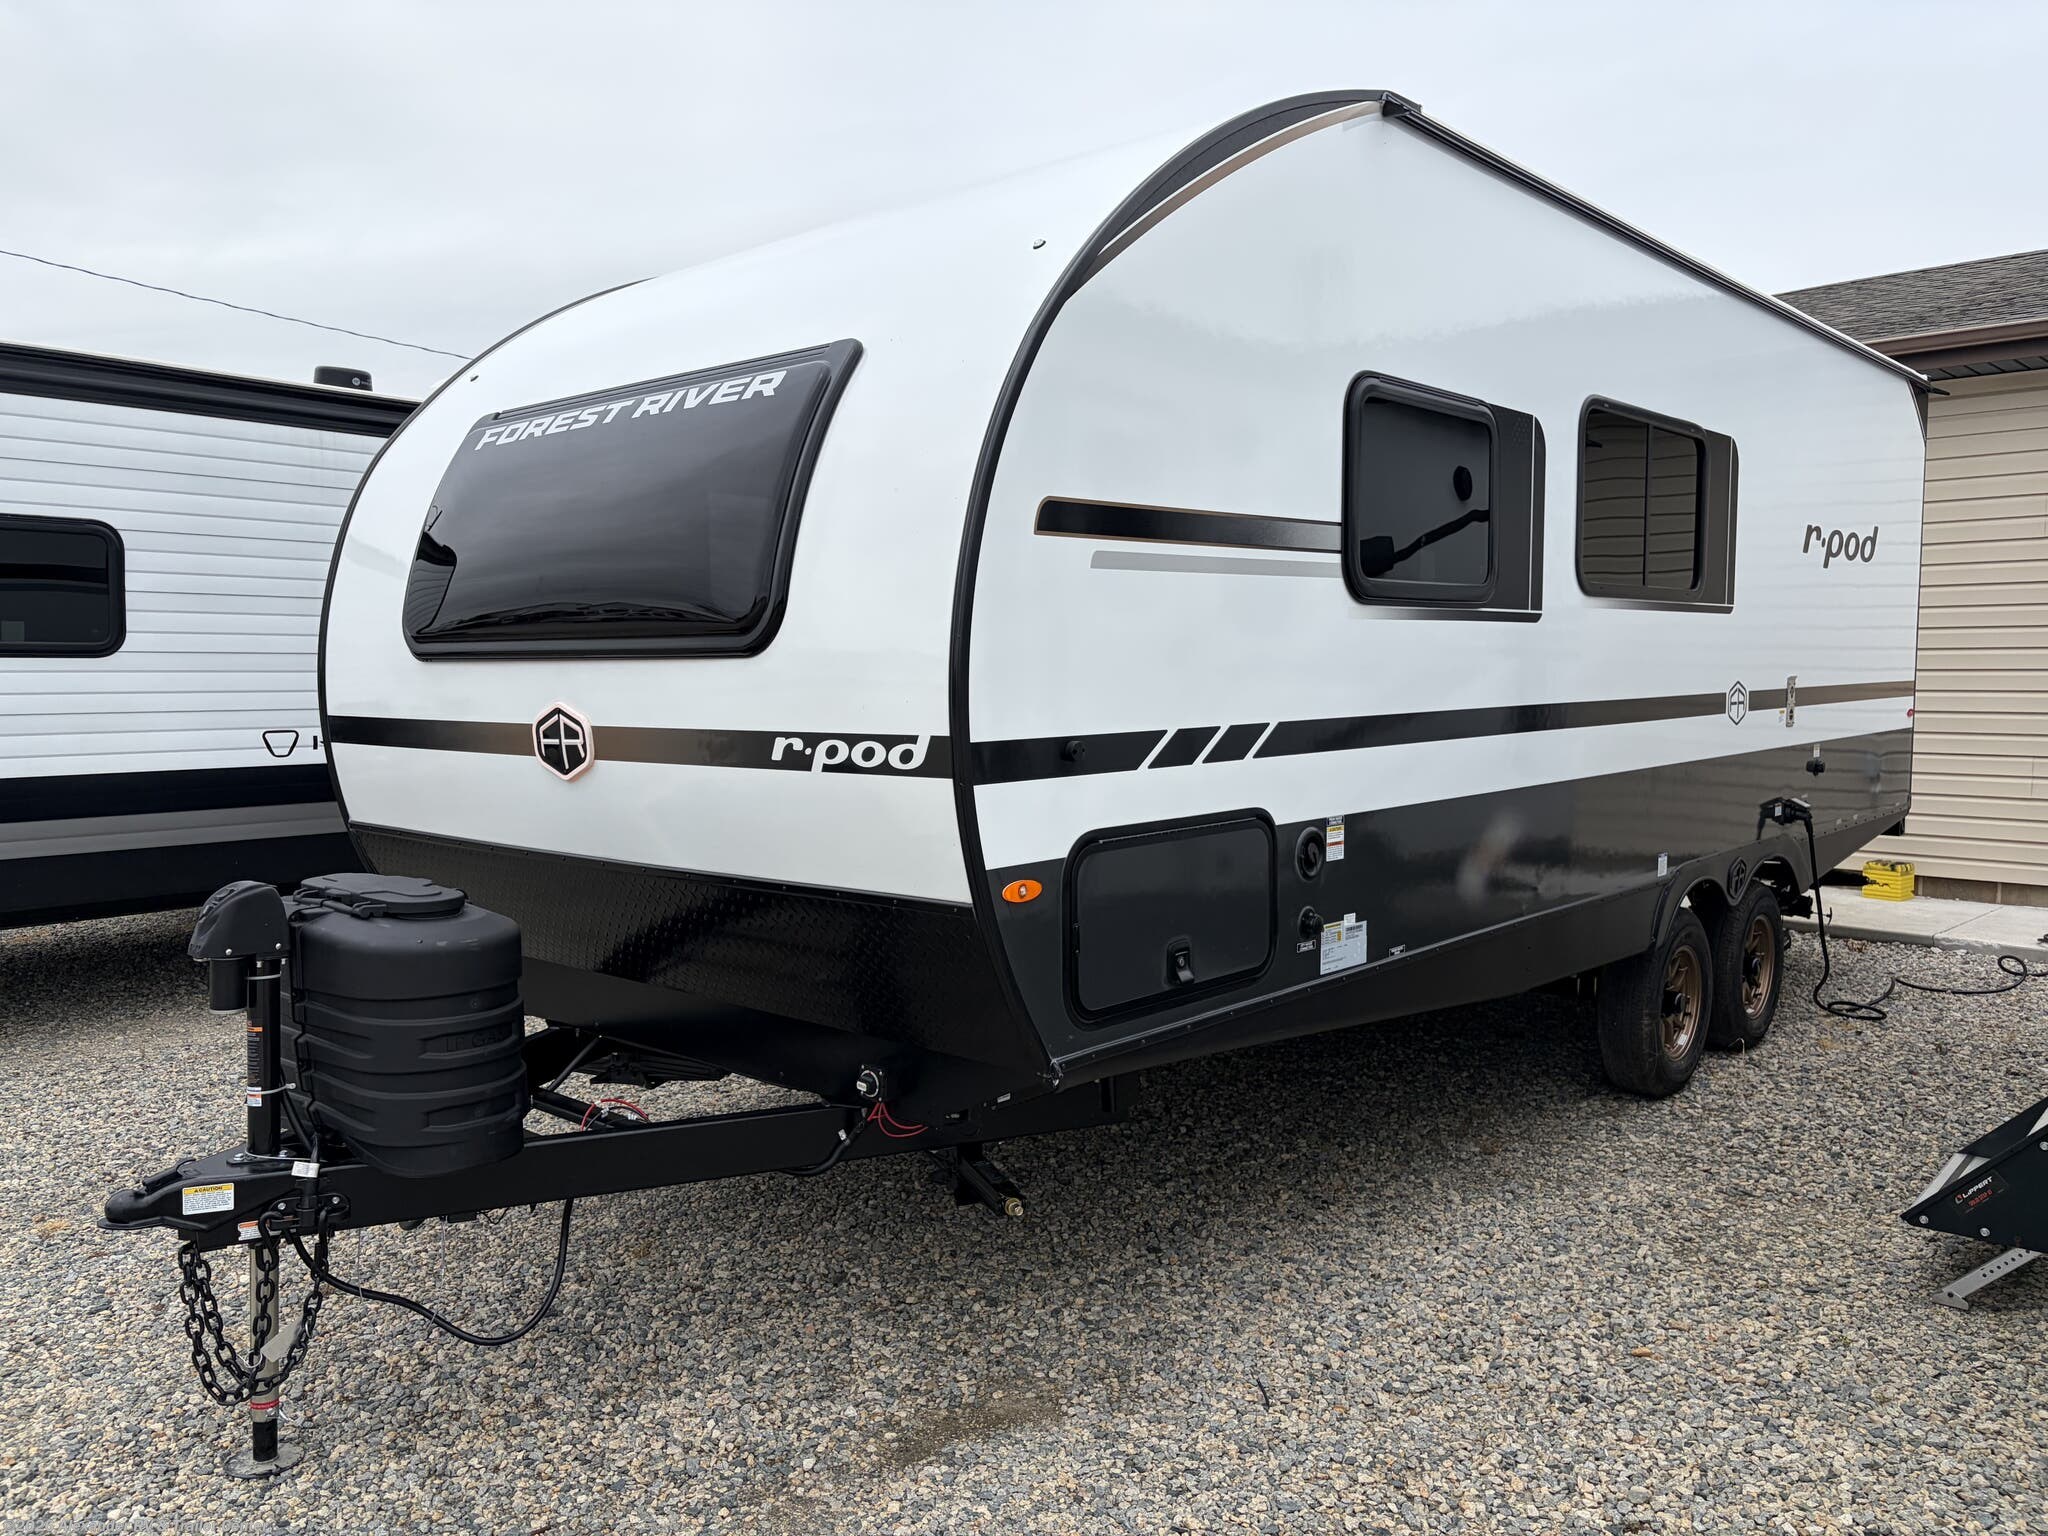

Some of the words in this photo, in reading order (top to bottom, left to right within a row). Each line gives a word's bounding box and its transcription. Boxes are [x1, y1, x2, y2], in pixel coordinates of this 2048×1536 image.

[475, 400, 636, 450] FOREST
[632, 371, 787, 418] RIVER
[1962, 1176, 1992, 1198] LIPPERT
